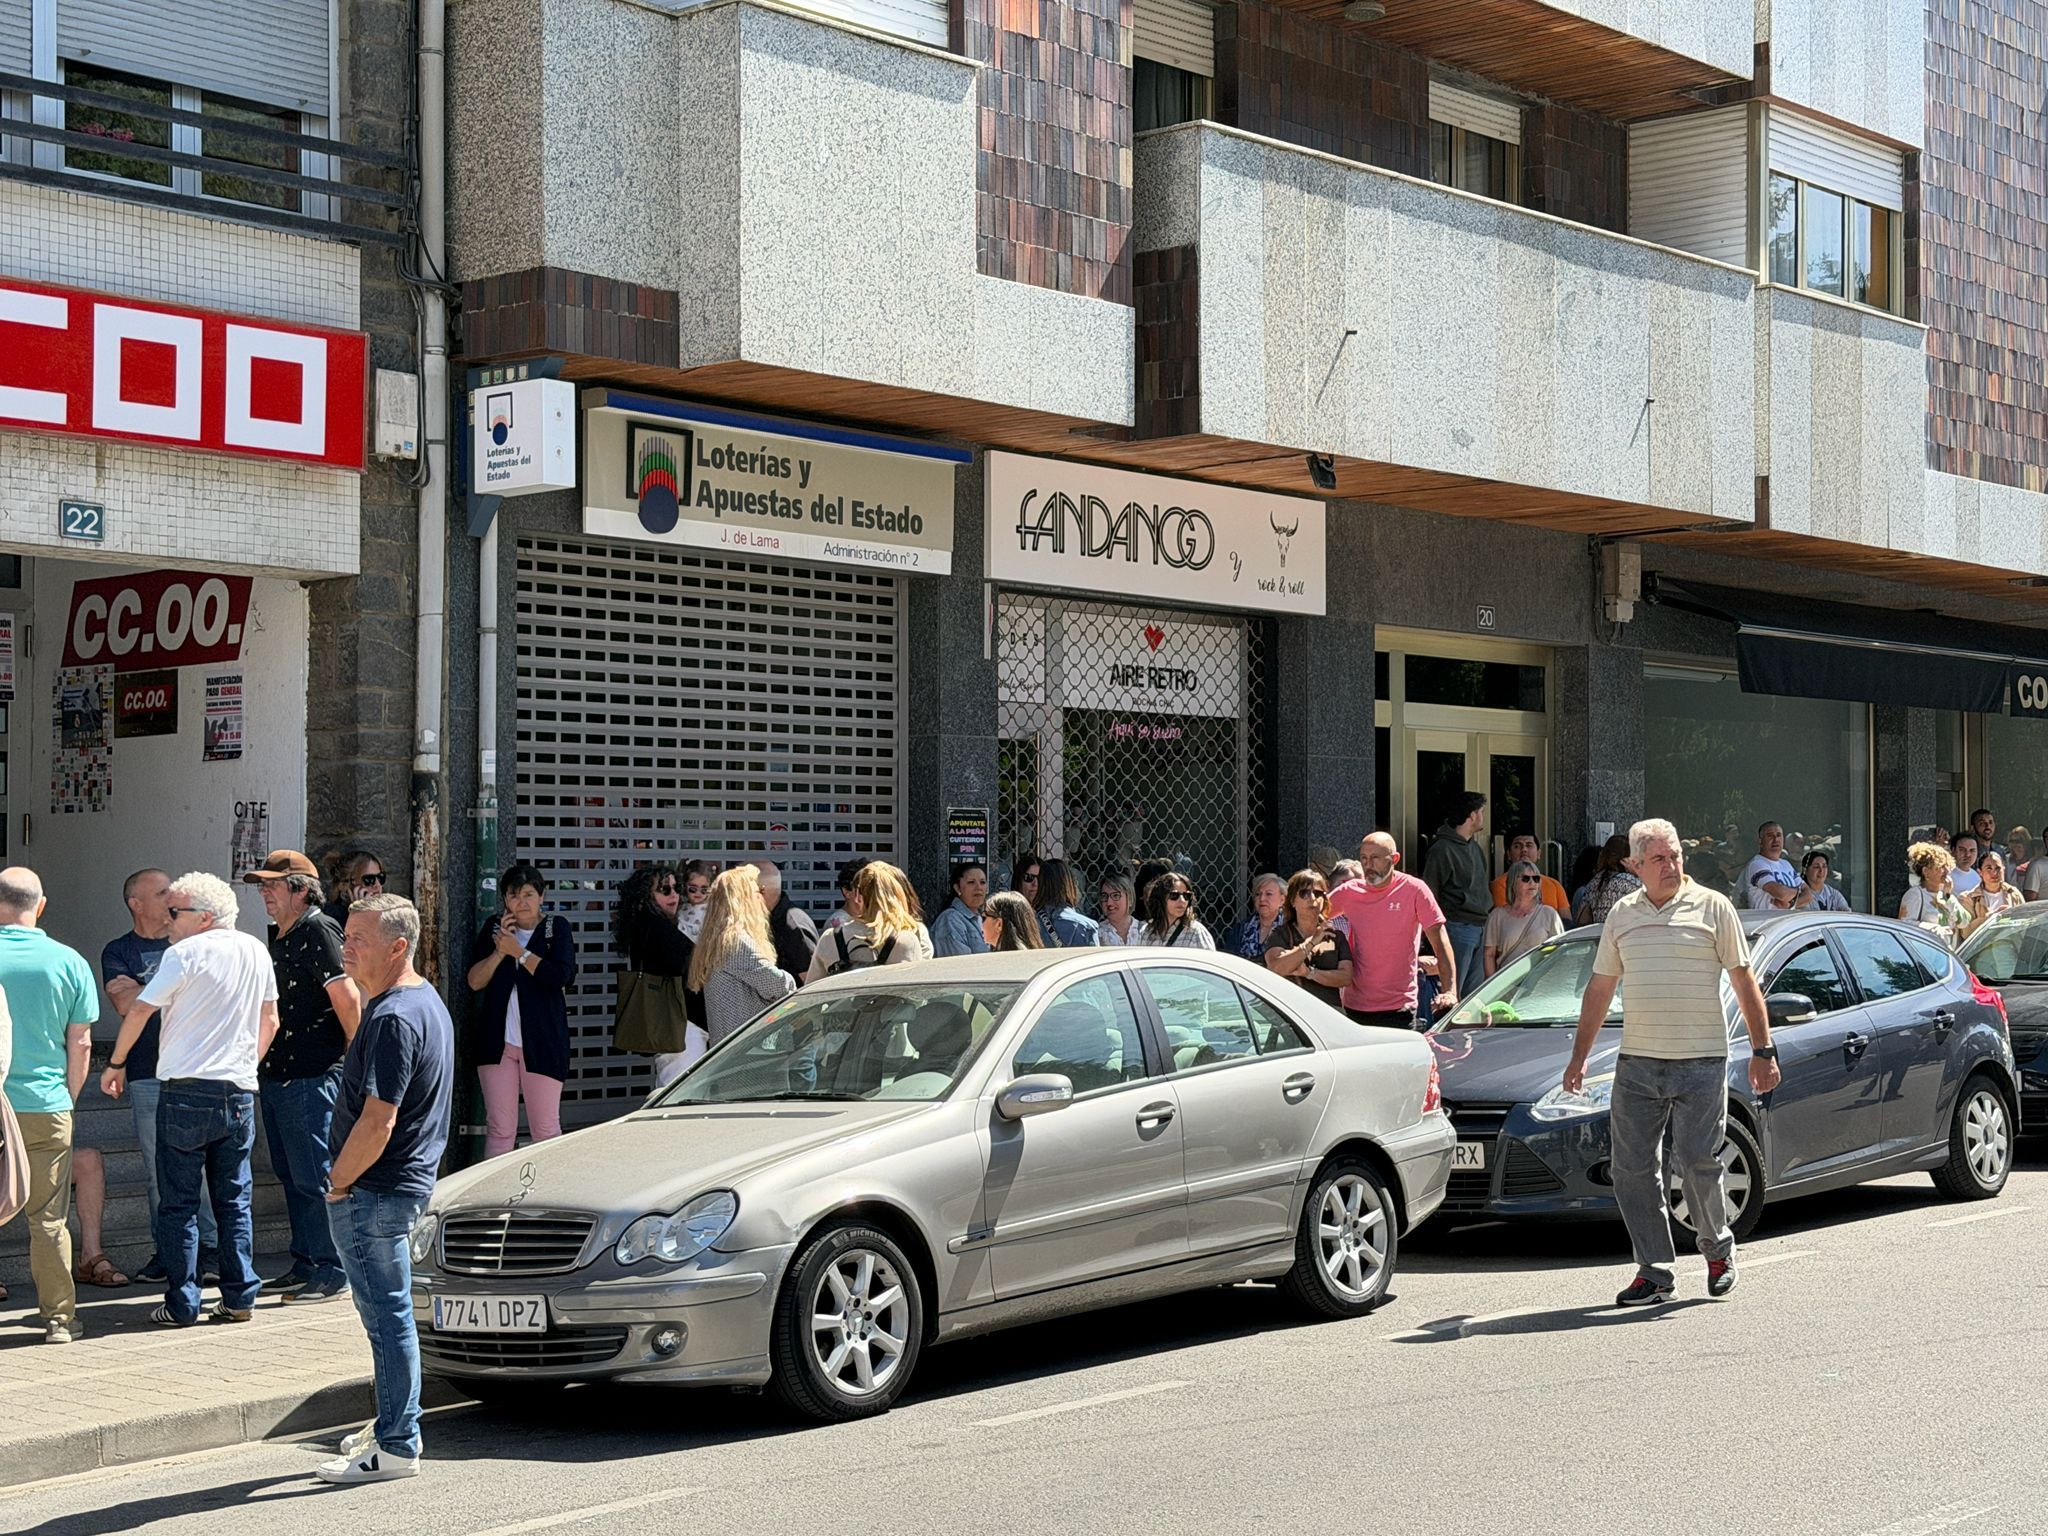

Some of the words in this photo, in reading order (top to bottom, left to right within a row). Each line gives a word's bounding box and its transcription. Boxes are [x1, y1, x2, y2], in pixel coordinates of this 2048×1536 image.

[486, 446, 514, 458] Loterías
[516, 446, 521, 456] y
[486, 459, 518, 471] Apuestas
[520, 455, 531, 464] del
[696, 438, 792, 479] Loterías
[798, 460, 811, 488] y
[486, 470, 511, 482] Estado
[696, 479, 803, 518] Apuestas
[810, 493, 844, 525] del
[851, 500, 923, 535] Estado
[66, 507, 99, 535] 22
[1016, 489, 1215, 571] FANDANGO
[721, 528, 730, 544] J.
[733, 529, 748, 546] de
[750, 531, 780, 549] Lama
[823, 541, 899, 564] Administración
[912, 552, 919, 567] 2
[1257, 577, 1276, 593] rock
[1288, 580, 1305, 596] roll
[73, 578, 242, 660] CC.OO.
[1479, 609, 1493, 626] 20
[1109, 663, 1145, 688] AIRE
[1147, 666, 1198, 692] RETRO
[124, 689, 168, 710] CC.OO.
[220, 686, 242, 695] GENERAL
[234, 801, 268, 819] CITE
[966, 826, 986, 835] PEÑA
[959, 845, 976, 853] PIN
[1451, 1145, 1479, 1165] RX
[444, 1300, 491, 1326] 7741
[499, 1301, 542, 1328] DPZ
